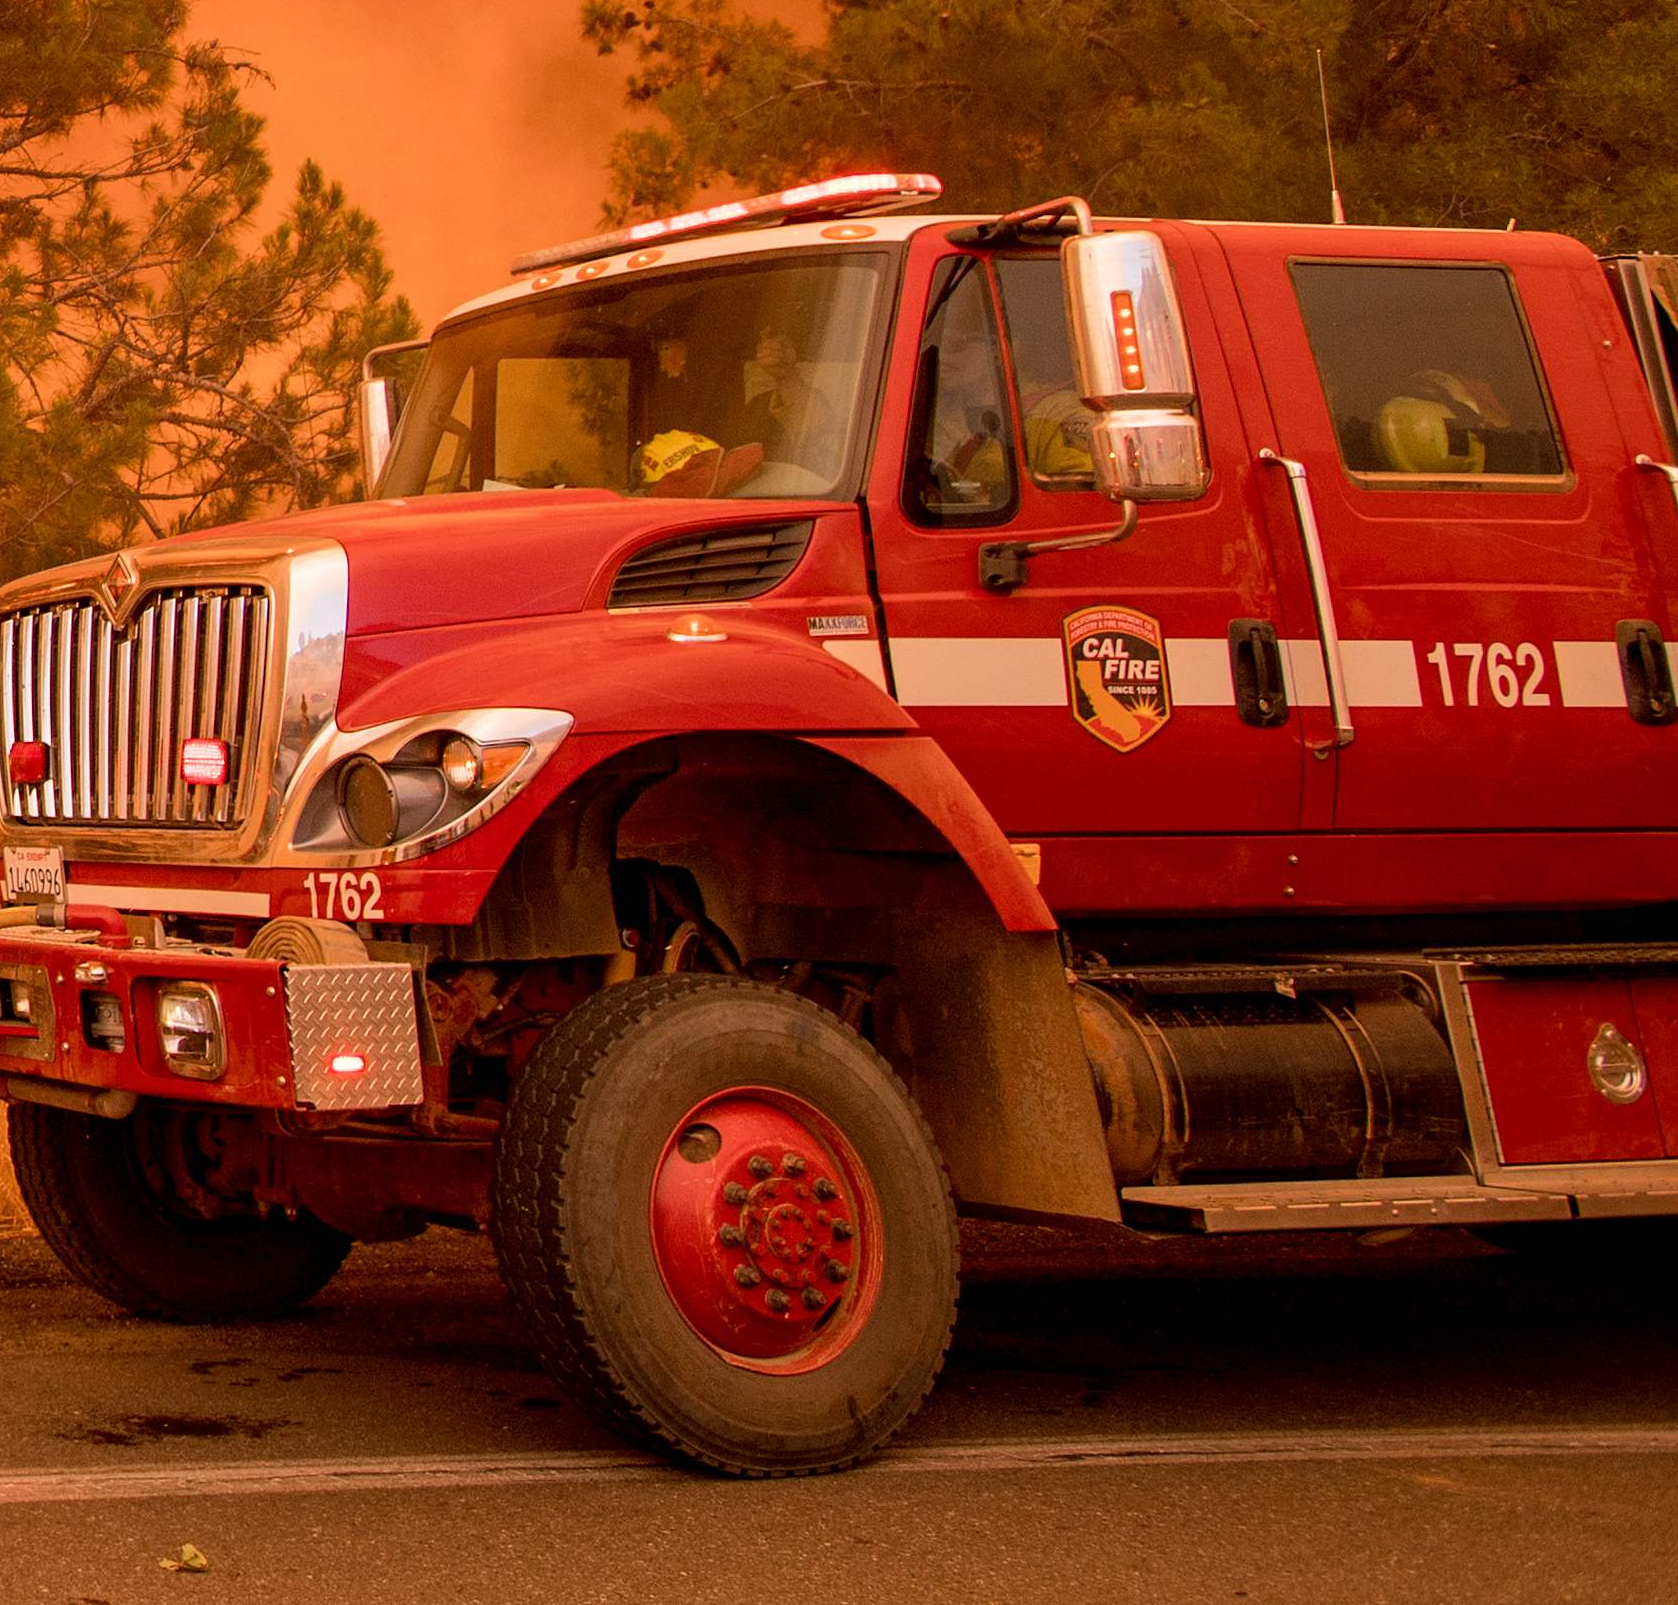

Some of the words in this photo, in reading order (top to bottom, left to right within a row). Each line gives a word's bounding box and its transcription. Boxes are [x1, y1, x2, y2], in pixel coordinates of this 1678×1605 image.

[1083, 638, 1129, 658] CAL
[1104, 660, 1160, 679] FIRE
[1427, 642, 1550, 708] 1762
[1107, 686, 1134, 694] SINCE
[1136, 686, 1157, 694] 1885
[9, 867, 61, 895] 1460996
[304, 872, 384, 920] 1762
